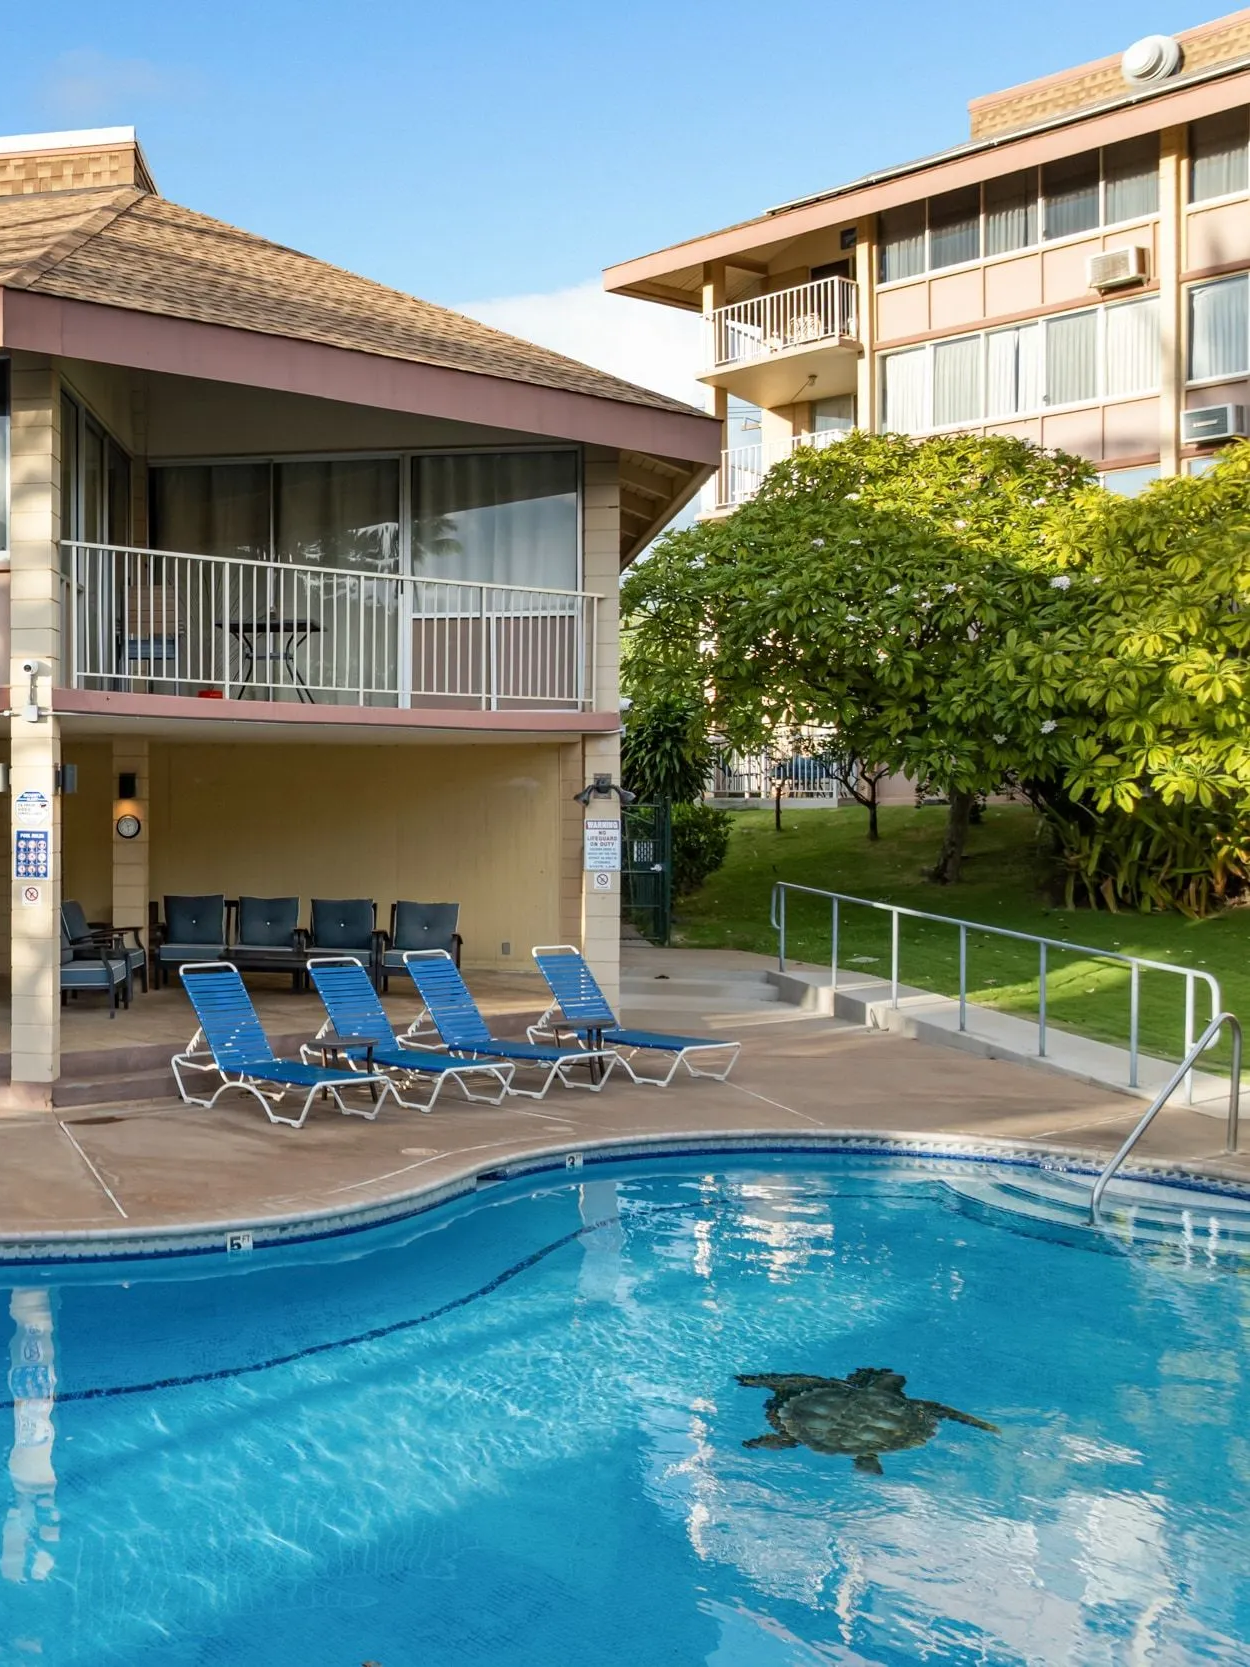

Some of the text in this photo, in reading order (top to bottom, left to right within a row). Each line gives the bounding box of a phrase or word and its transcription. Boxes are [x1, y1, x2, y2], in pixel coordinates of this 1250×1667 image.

[587, 821, 618, 829] WARNING
[230, 1234, 250, 1250] 5 FT
